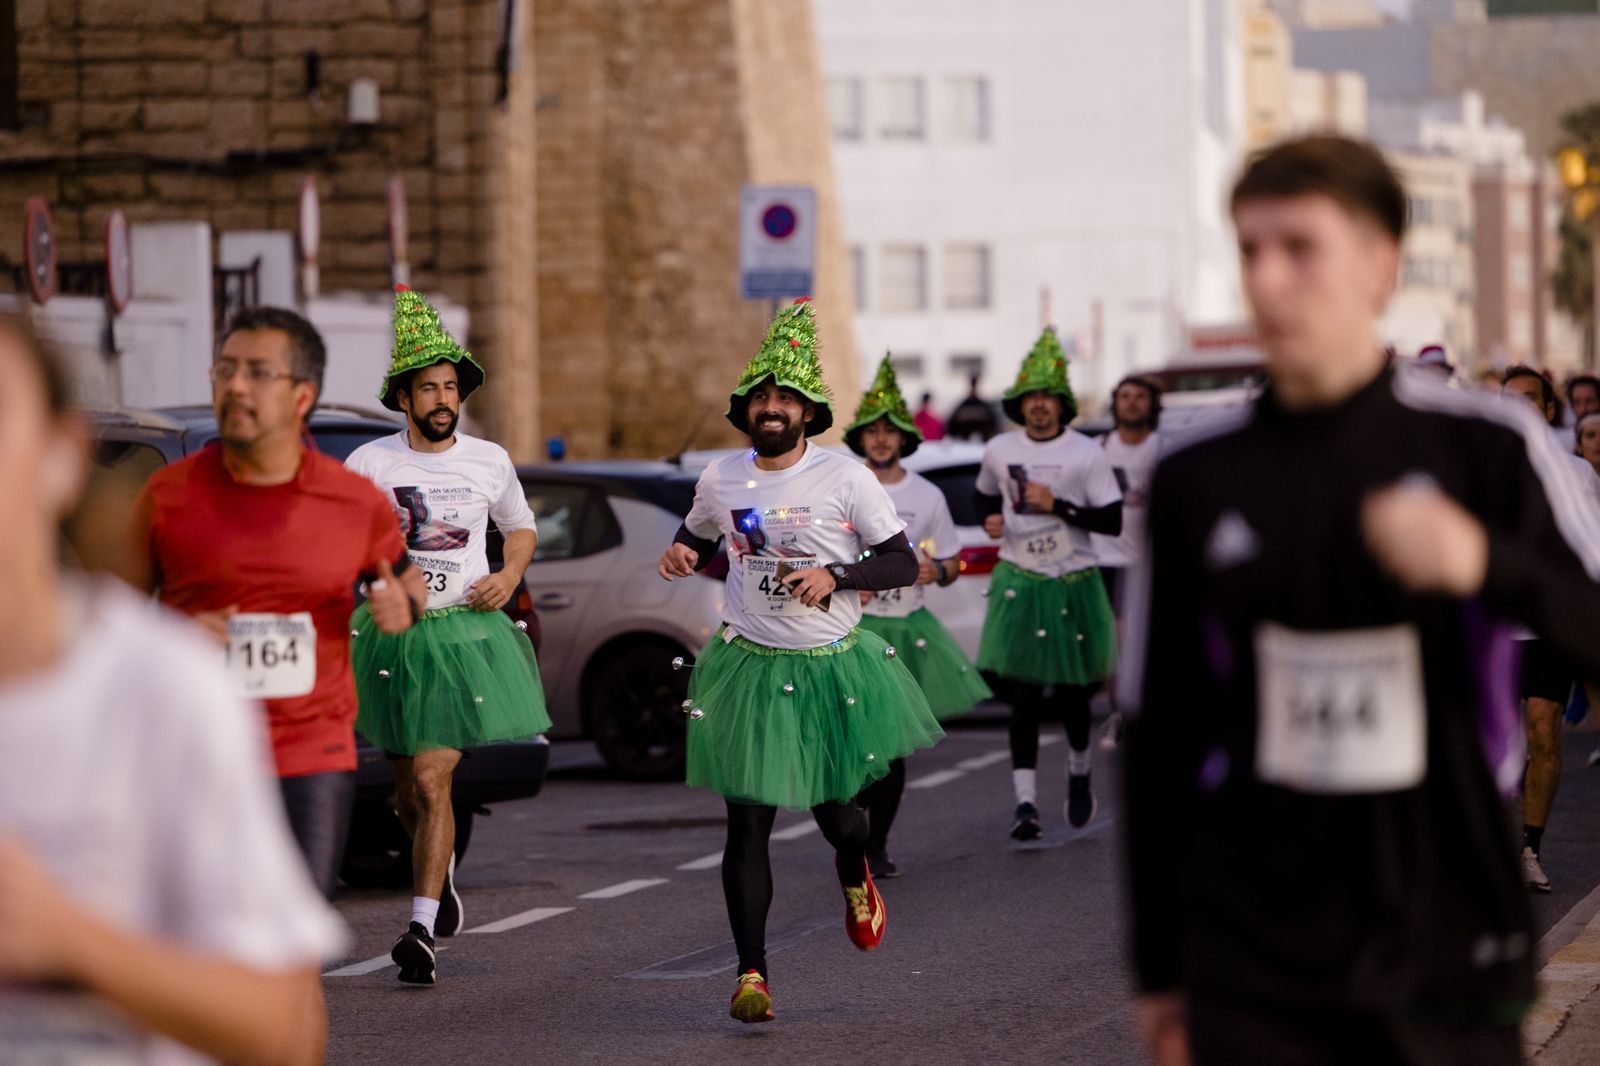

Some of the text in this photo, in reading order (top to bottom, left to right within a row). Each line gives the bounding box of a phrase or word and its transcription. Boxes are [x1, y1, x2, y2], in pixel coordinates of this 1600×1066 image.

[765, 518, 785, 526] CIUDAD
[786, 517, 794, 525] DE
[1026, 535, 1057, 554] 425
[427, 562, 438, 570] DE
[748, 564, 775, 572] CIUDAD
[422, 571, 447, 592] 23
[758, 574, 786, 596] 42
